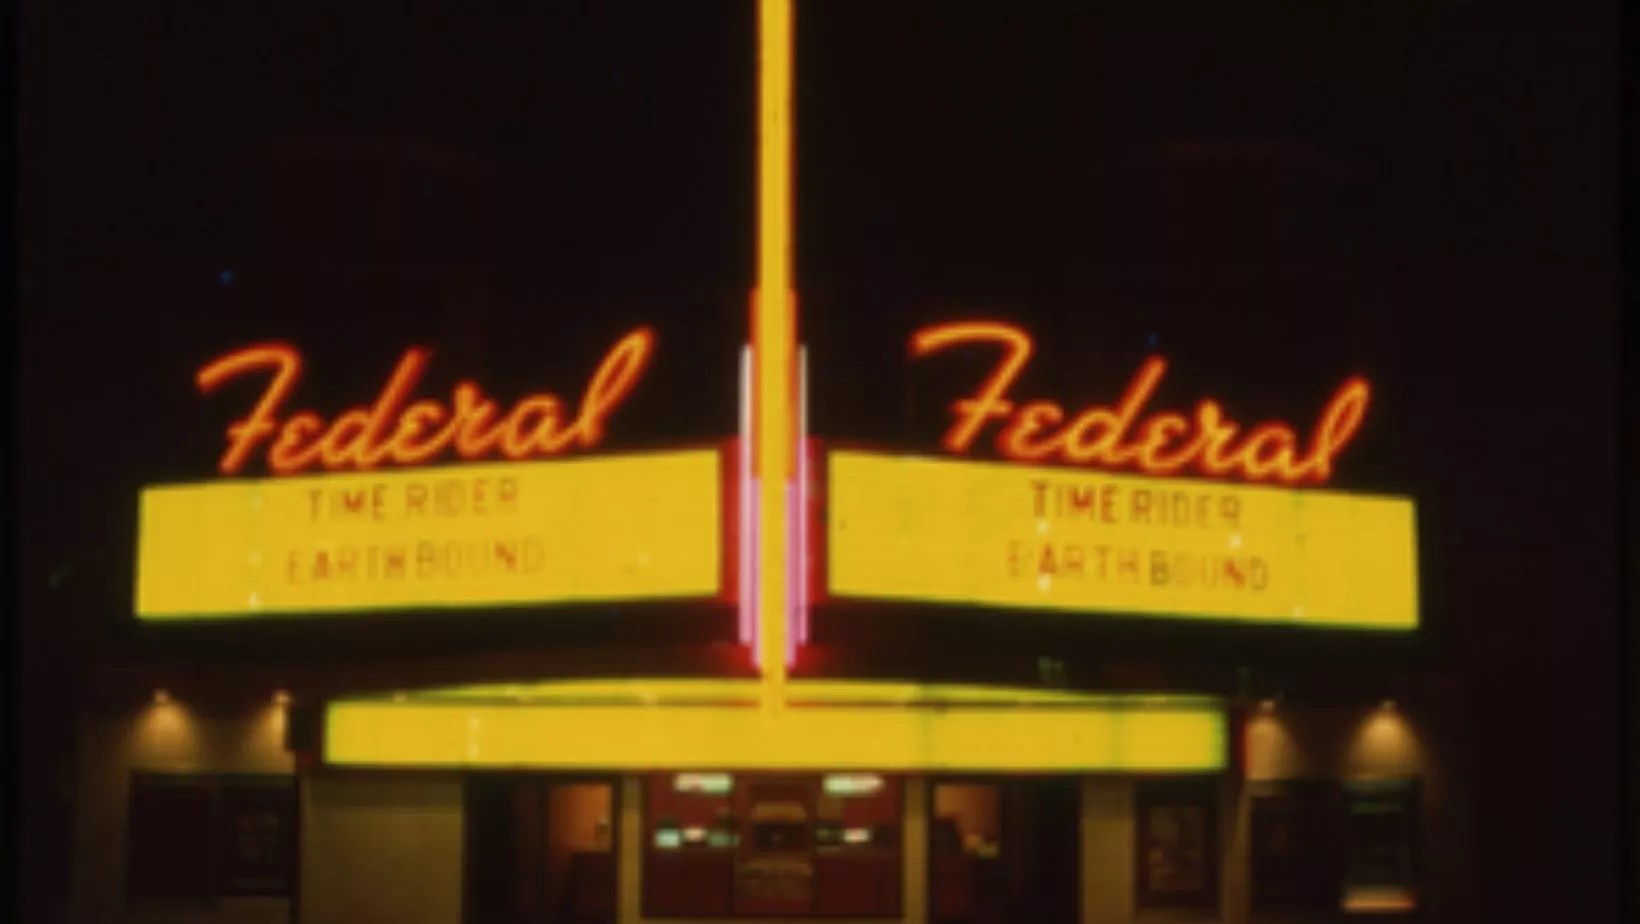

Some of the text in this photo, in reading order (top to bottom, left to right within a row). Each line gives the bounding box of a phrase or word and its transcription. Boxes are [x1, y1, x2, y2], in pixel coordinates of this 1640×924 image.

[197, 324, 657, 474] Federal
[909, 320, 1371, 482] Federal
[308, 477, 520, 523] TIME RIDER
[1031, 479, 1242, 527] TIME RIDER
